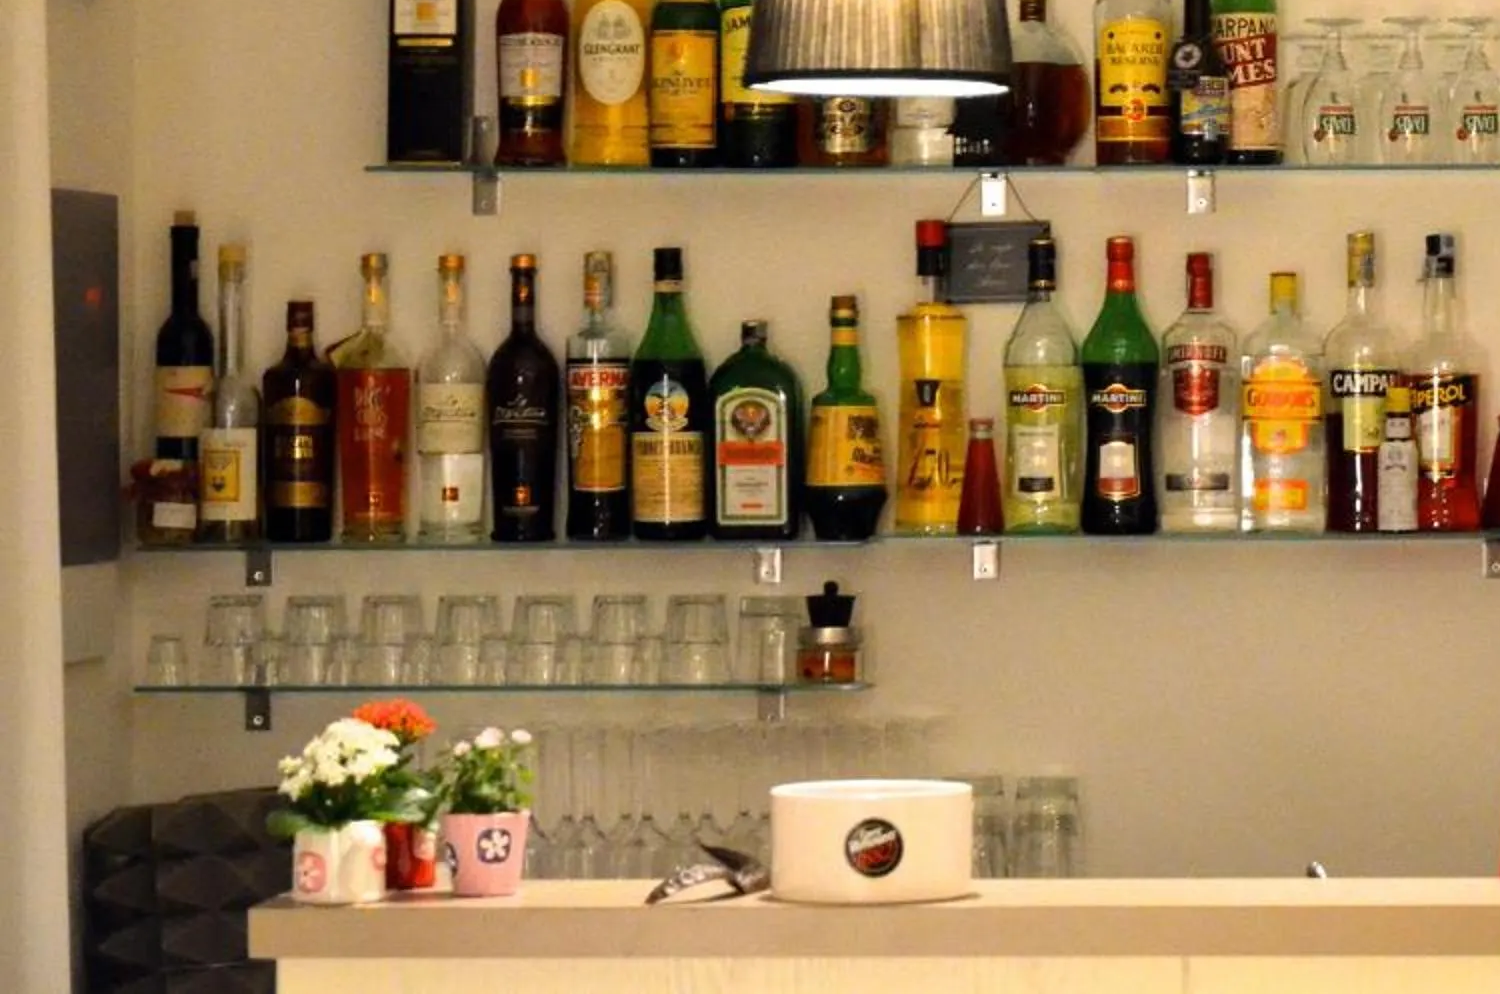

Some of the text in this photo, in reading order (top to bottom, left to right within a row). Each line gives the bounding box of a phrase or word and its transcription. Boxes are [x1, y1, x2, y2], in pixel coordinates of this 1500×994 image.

[1222, 37, 1267, 64] UNT
[1012, 393, 1062, 404] MARTINI
[1091, 393, 1143, 404] MARTINI
